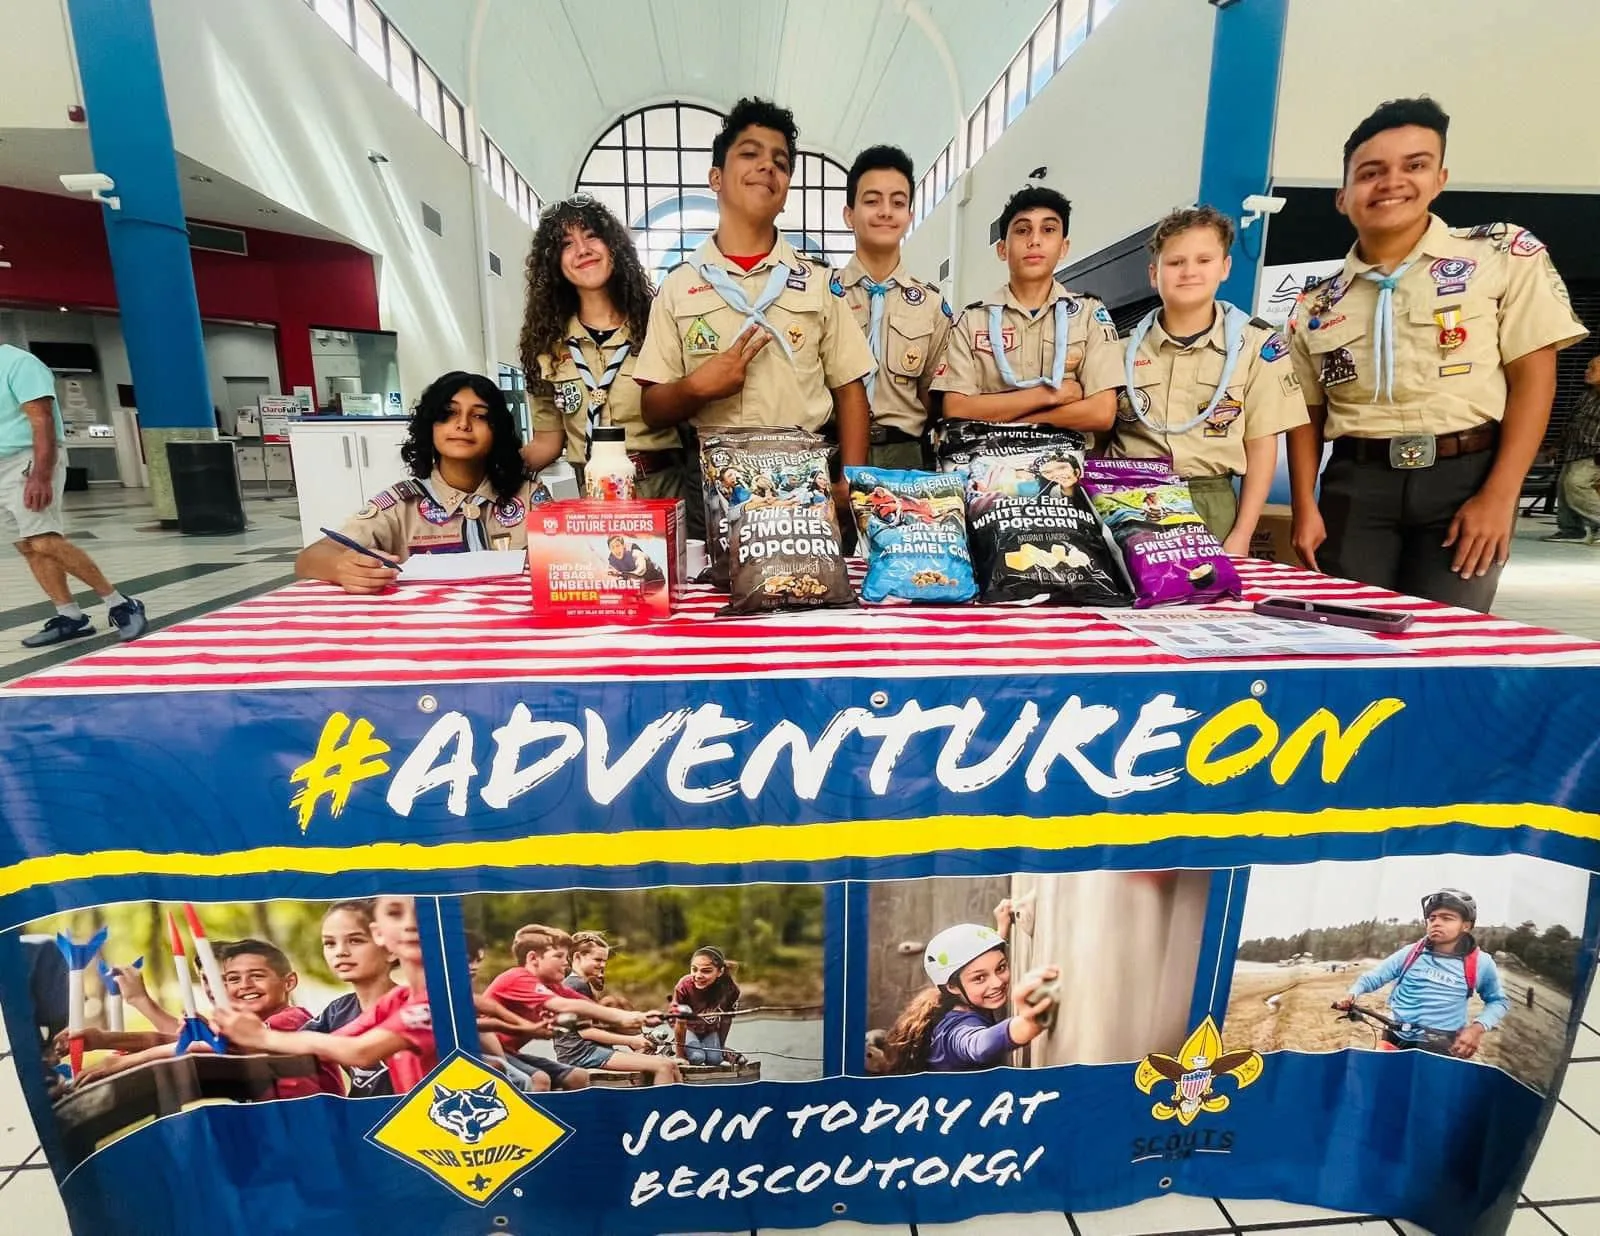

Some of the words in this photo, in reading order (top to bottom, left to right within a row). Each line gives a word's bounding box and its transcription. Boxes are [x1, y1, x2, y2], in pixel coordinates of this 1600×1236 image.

[745, 506, 788, 523] Trail's
[972, 507, 1022, 530] WHITE
[1024, 506, 1096, 525] CHEDDAR
[566, 520, 606, 532] FUTURE
[608, 519, 654, 532] LEADERS
[740, 519, 834, 543] S'MORES
[1000, 518, 1079, 531] POPCORN
[1153, 526, 1187, 540] Trail's
[902, 532, 958, 544] SALTED
[1133, 536, 1184, 555] SWEET
[738, 538, 840, 563] POPCORN
[1145, 546, 1198, 565] KETTLE
[562, 571, 595, 580] BAGS
[550, 580, 641, 591] UNBELIEVABLE
[550, 591, 598, 602] BUTTER
[289, 694, 1407, 835] #ADVENTUREON
[622, 1106, 774, 1157] JOIN
[786, 1095, 972, 1139] TODAY
[979, 1090, 1060, 1127] AT
[1132, 1128, 1236, 1155] SCOUTS
[416, 1150, 462, 1168] CUB
[462, 1145, 534, 1168] SCOUTS
[629, 1145, 1046, 1208] BEASCOUT.ORG!
